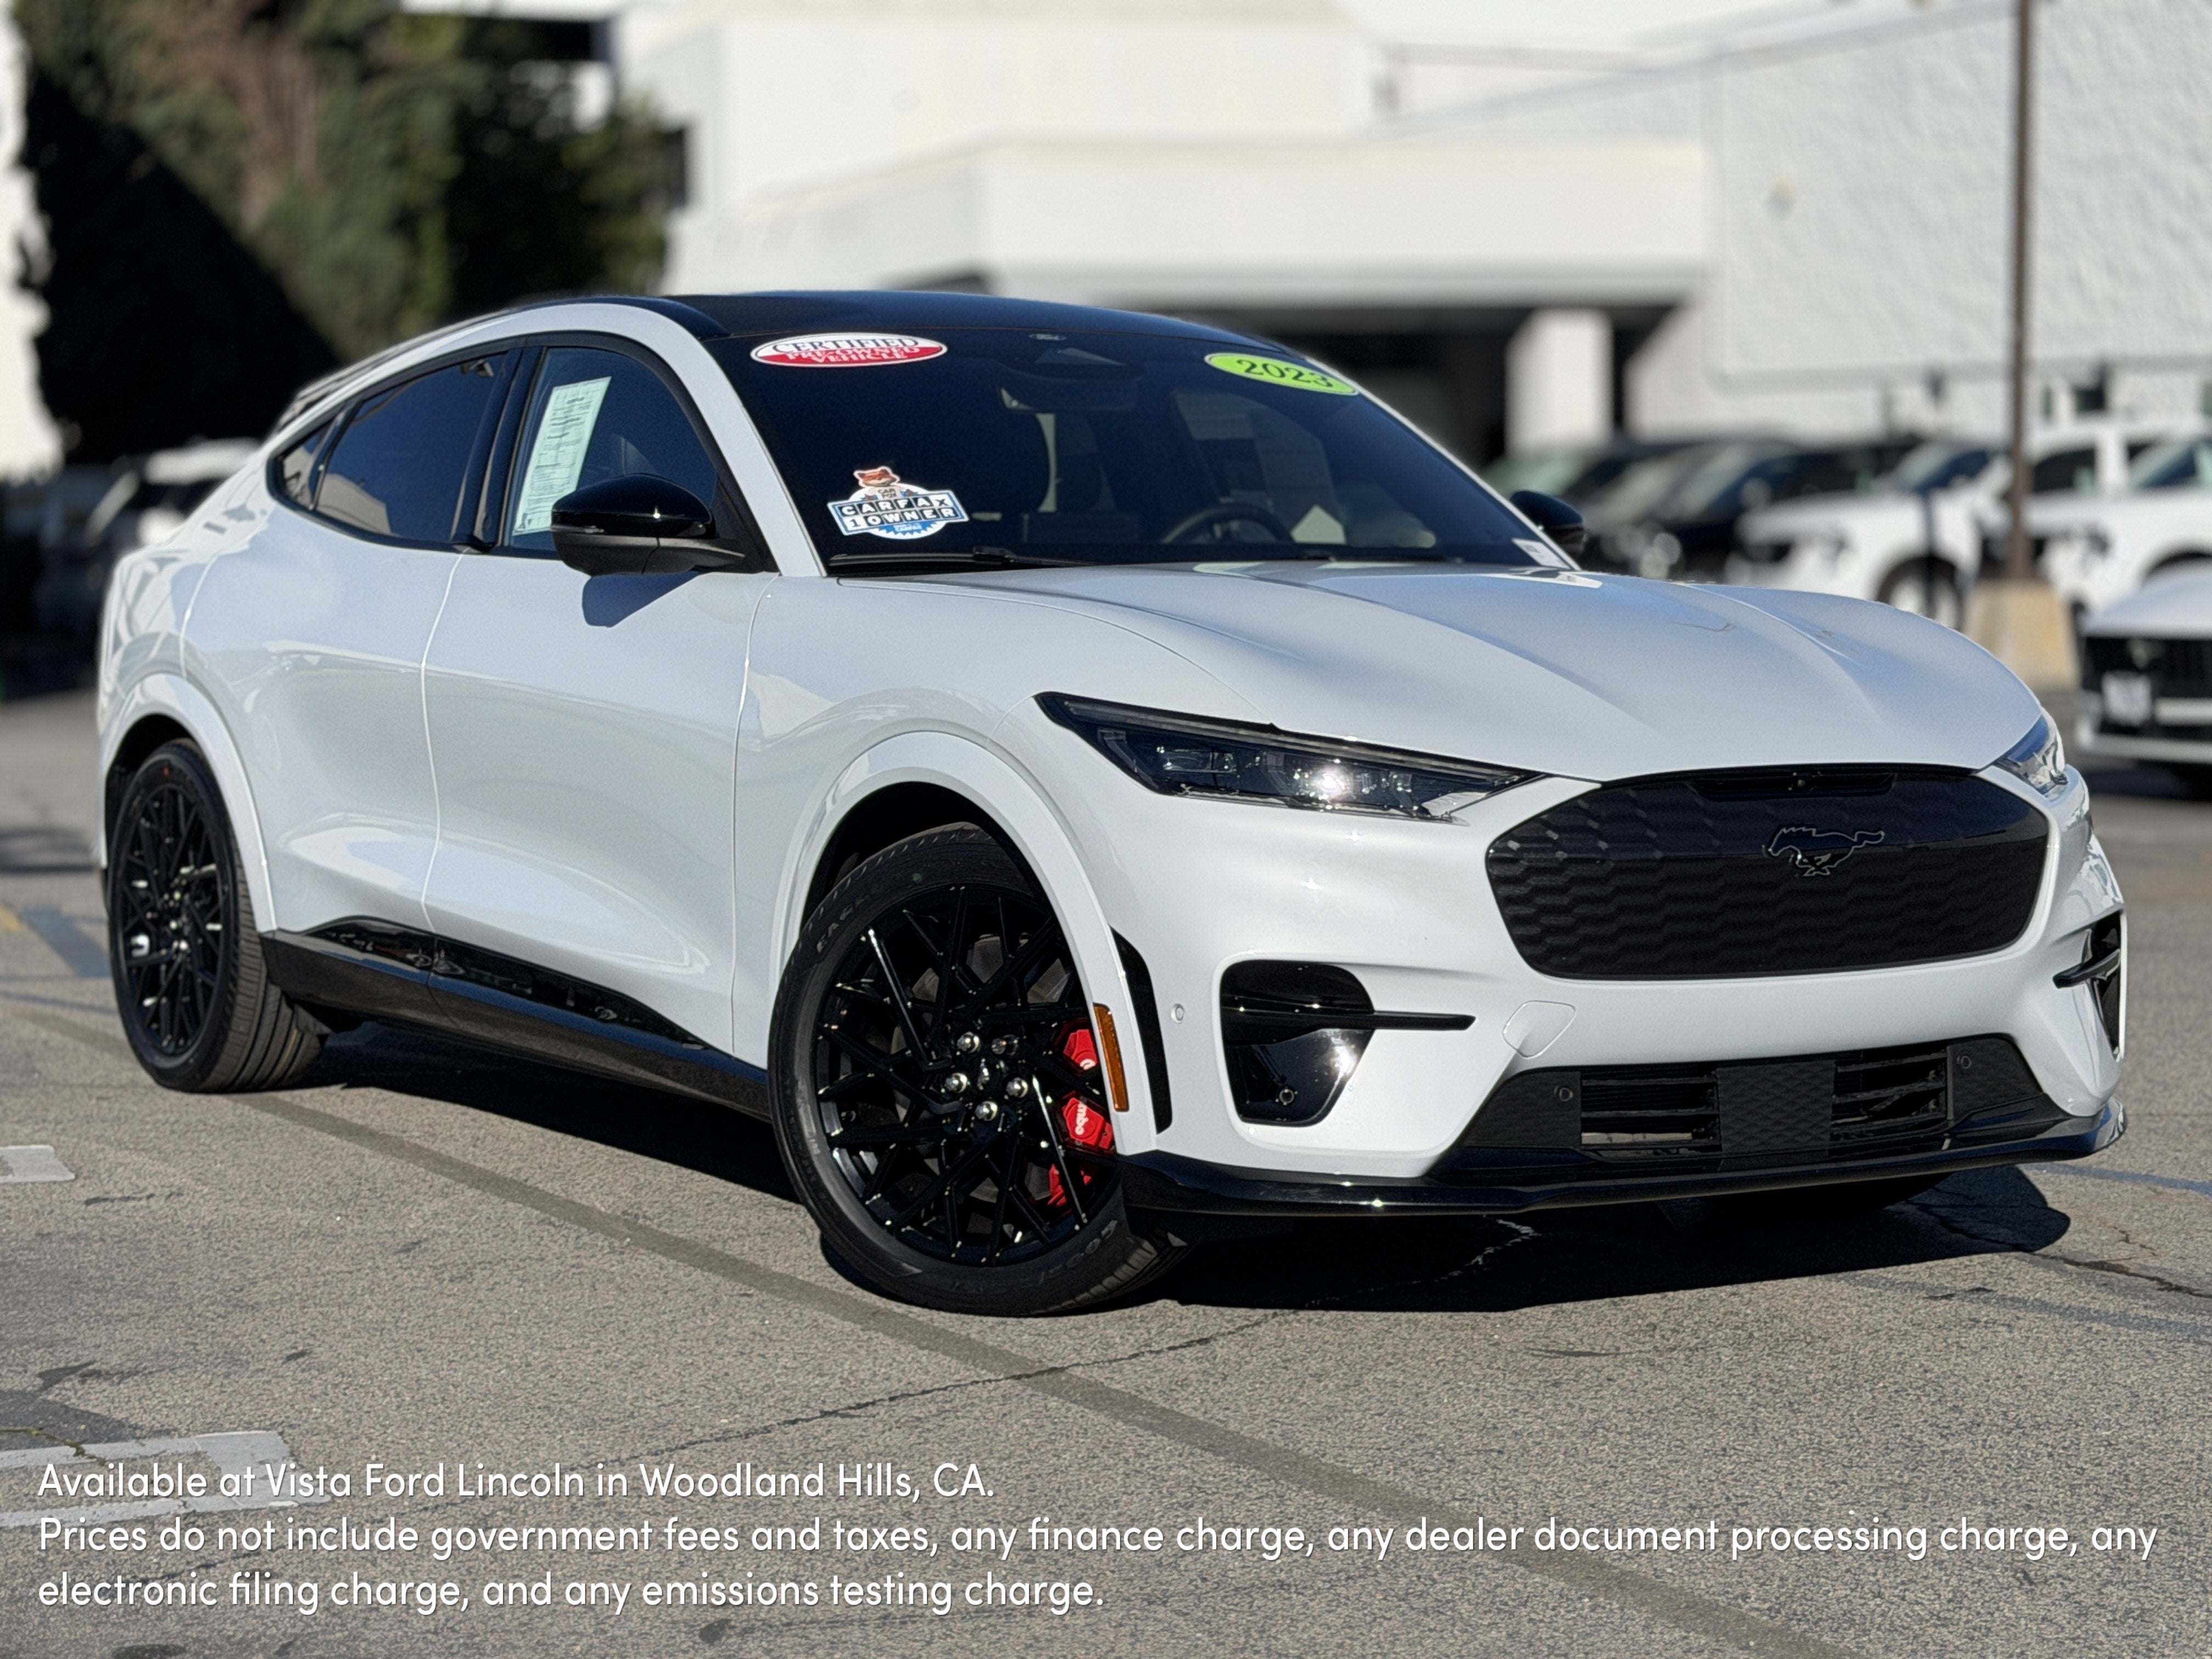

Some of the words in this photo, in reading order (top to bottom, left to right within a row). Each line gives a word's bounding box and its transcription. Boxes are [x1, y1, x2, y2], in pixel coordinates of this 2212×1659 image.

[772, 338, 919, 354] CERTIFIED
[786, 347, 920, 360] PRE-OWNED
[811, 352, 909, 363] VEHICLE
[1236, 359, 1334, 388] 2023
[841, 497, 949, 516] CARFAX
[850, 518, 861, 527] 1
[867, 508, 956, 526] OWNER
